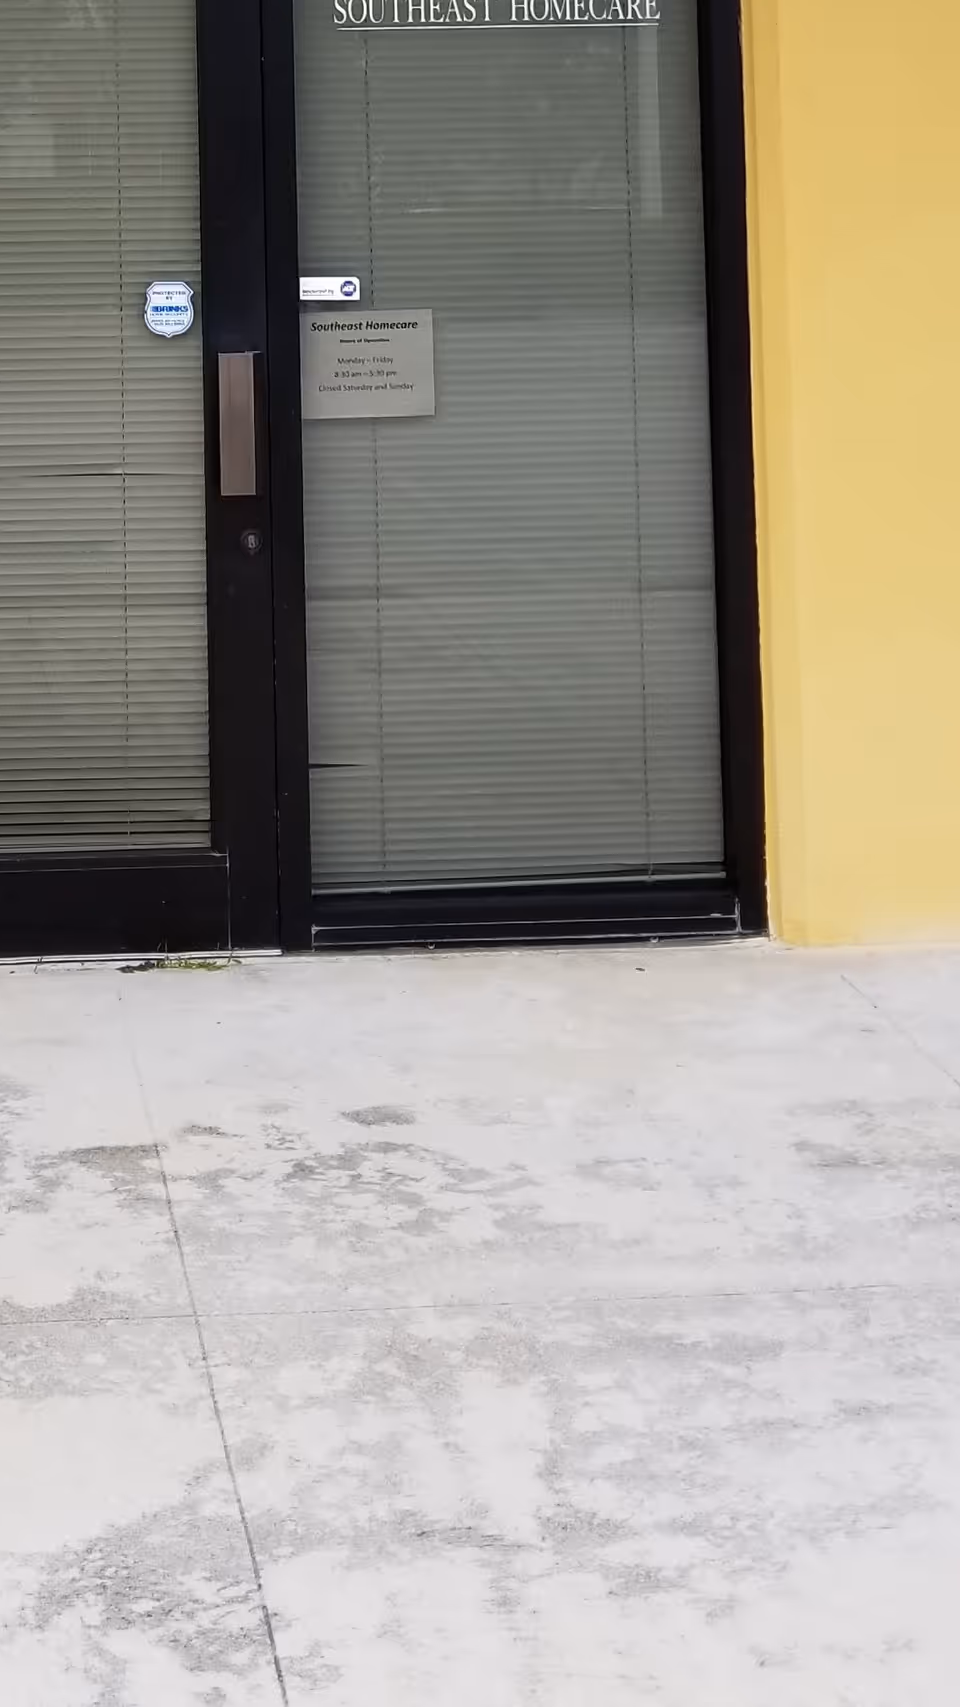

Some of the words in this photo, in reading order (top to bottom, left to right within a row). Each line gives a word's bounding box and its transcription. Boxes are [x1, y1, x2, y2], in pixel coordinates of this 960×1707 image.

[310, 321, 363, 332] Southeast
[365, 320, 419, 331] Homecare
[337, 357, 365, 365] Monday
[373, 356, 394, 364] Friday
[319, 384, 342, 393] Closed
[343, 383, 374, 393] Saturday
[375, 383, 388, 391] and
[389, 382, 414, 392] Sunday
